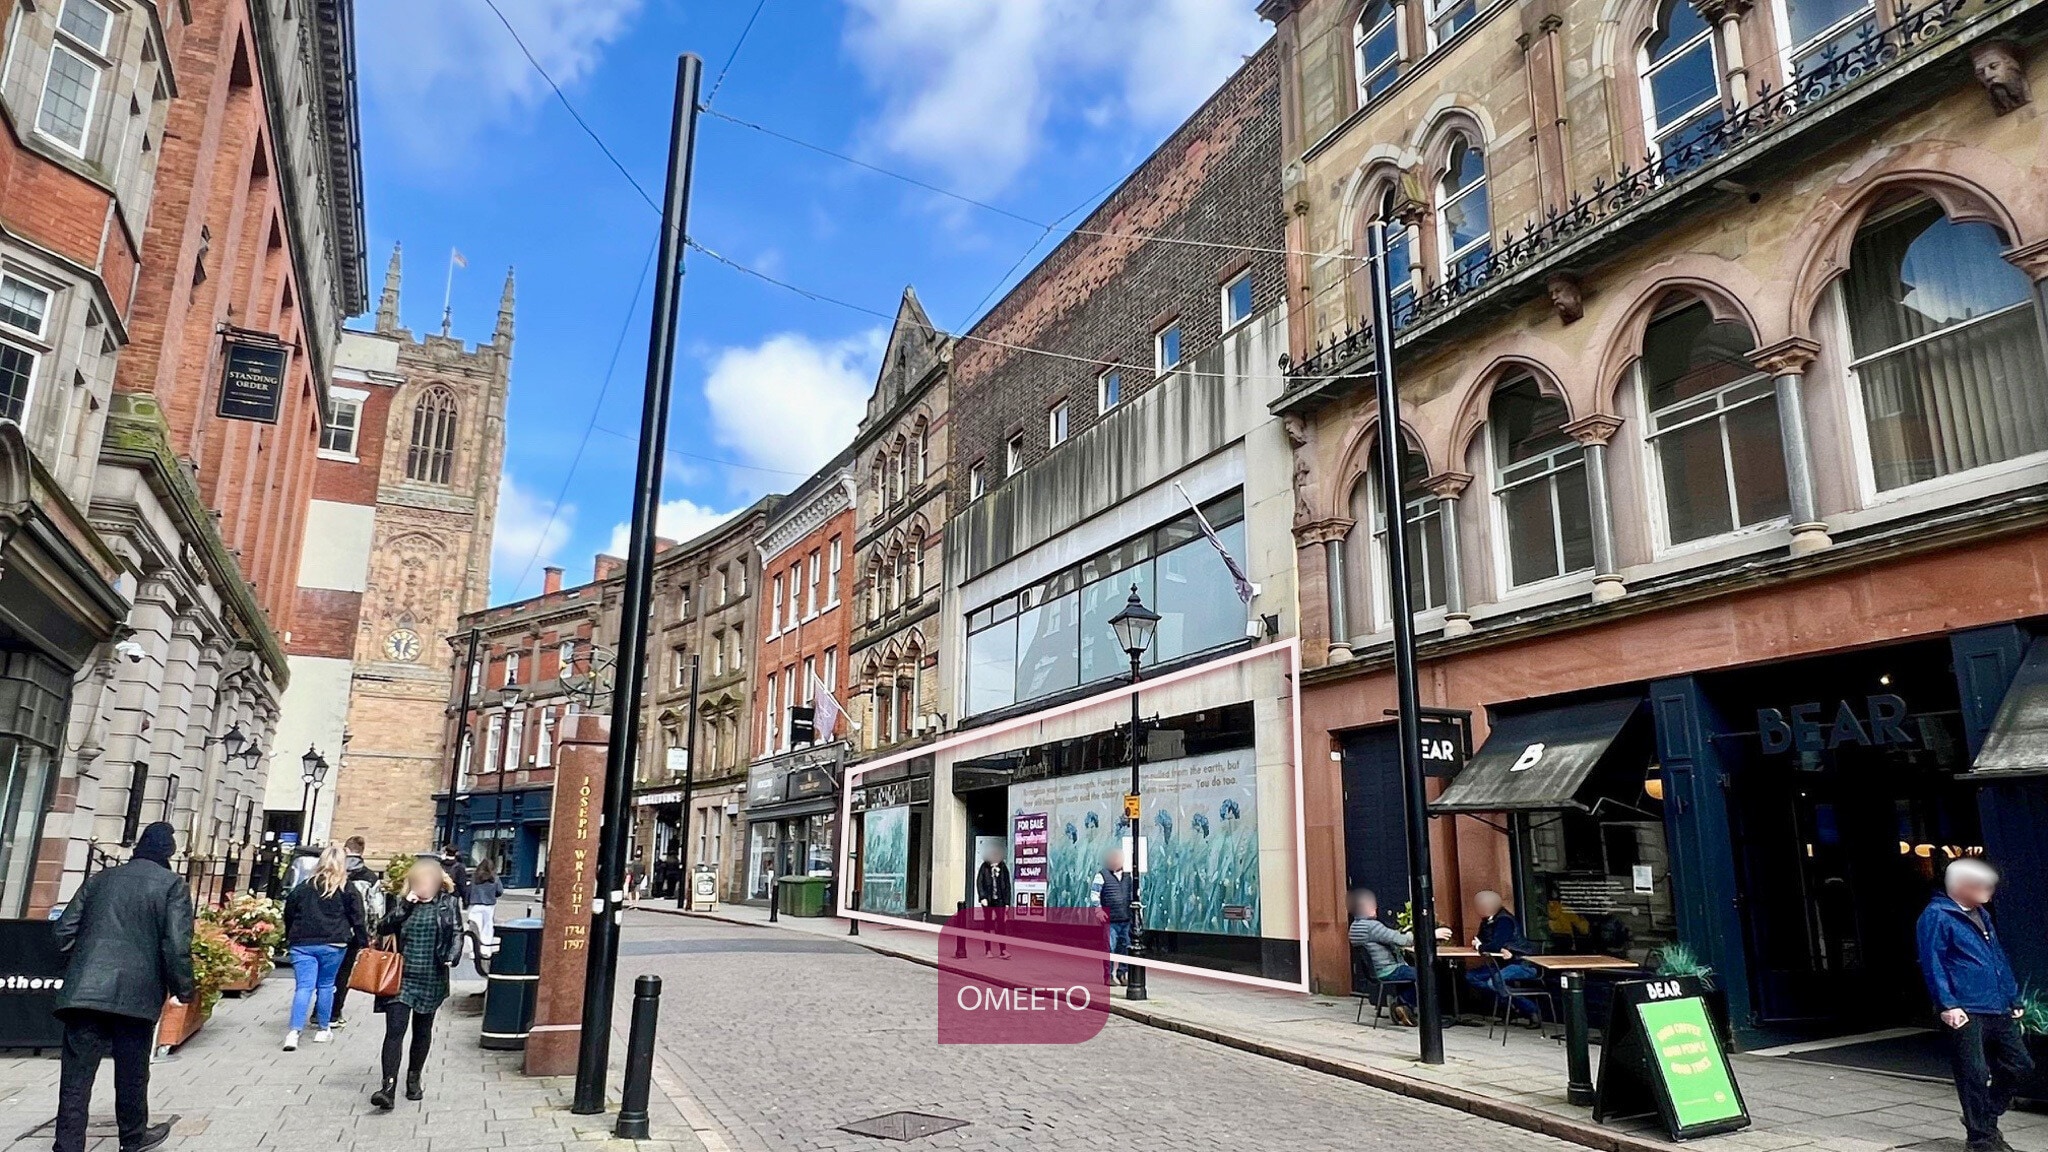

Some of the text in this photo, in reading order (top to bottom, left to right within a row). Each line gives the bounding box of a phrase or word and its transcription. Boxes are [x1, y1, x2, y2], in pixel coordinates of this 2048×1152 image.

[229, 371, 278, 385] STANDING
[235, 381, 269, 391] ORDER
[1757, 694, 1914, 755] BEAR
[1420, 738, 1454, 761] EAR
[1509, 742, 1545, 772] B
[1190, 765, 1202, 775] the
[1203, 762, 1225, 773] earth,
[1227, 760, 1240, 770] but
[1196, 779, 1210, 788] You
[1212, 776, 1221, 787] do
[1223, 777, 1238, 785] too.
[1017, 819, 1044, 831] FOR SALE
[572, 776, 591, 915] JOSEPH WRIGHT
[564, 925, 586, 937] 1734
[563, 940, 585, 951] 1797
[1646, 980, 1682, 999] BEAR
